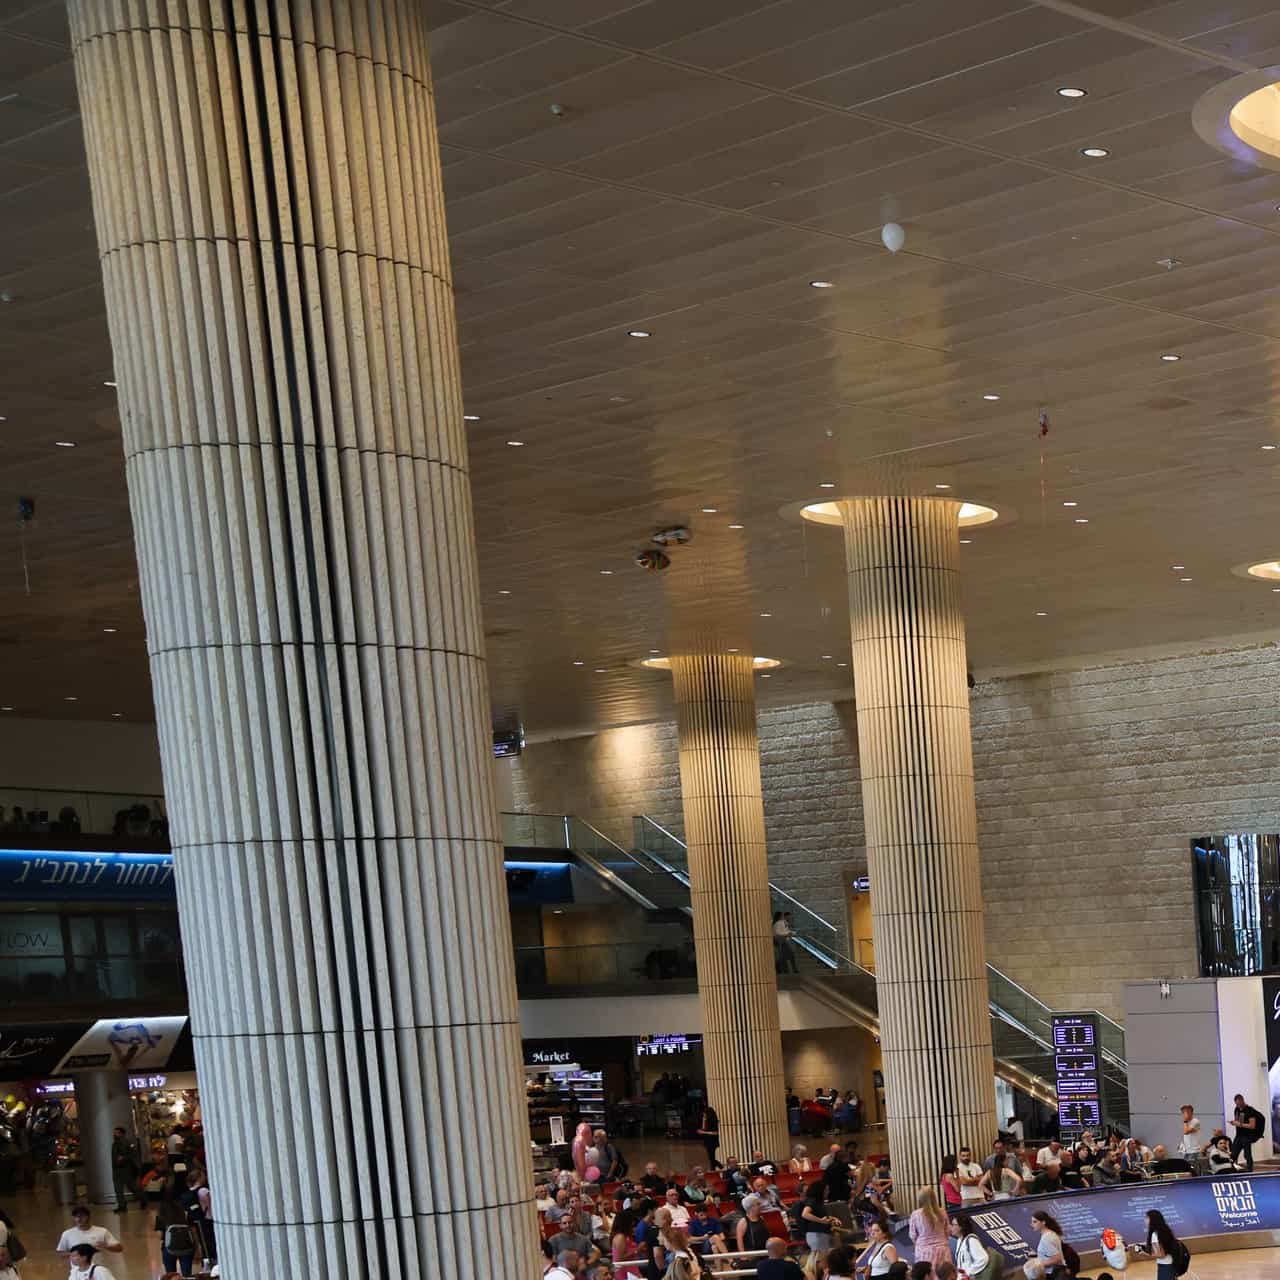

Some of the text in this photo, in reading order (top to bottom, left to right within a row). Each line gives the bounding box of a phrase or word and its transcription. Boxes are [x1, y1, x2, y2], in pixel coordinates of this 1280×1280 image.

[114, 859, 174, 885] לחזור
[532, 1051, 570, 1062] Market
[1211, 1180, 1254, 1197] ברוכים
[1215, 1195, 1256, 1212] הבאים
[1218, 1211, 1258, 1219] Welcome
